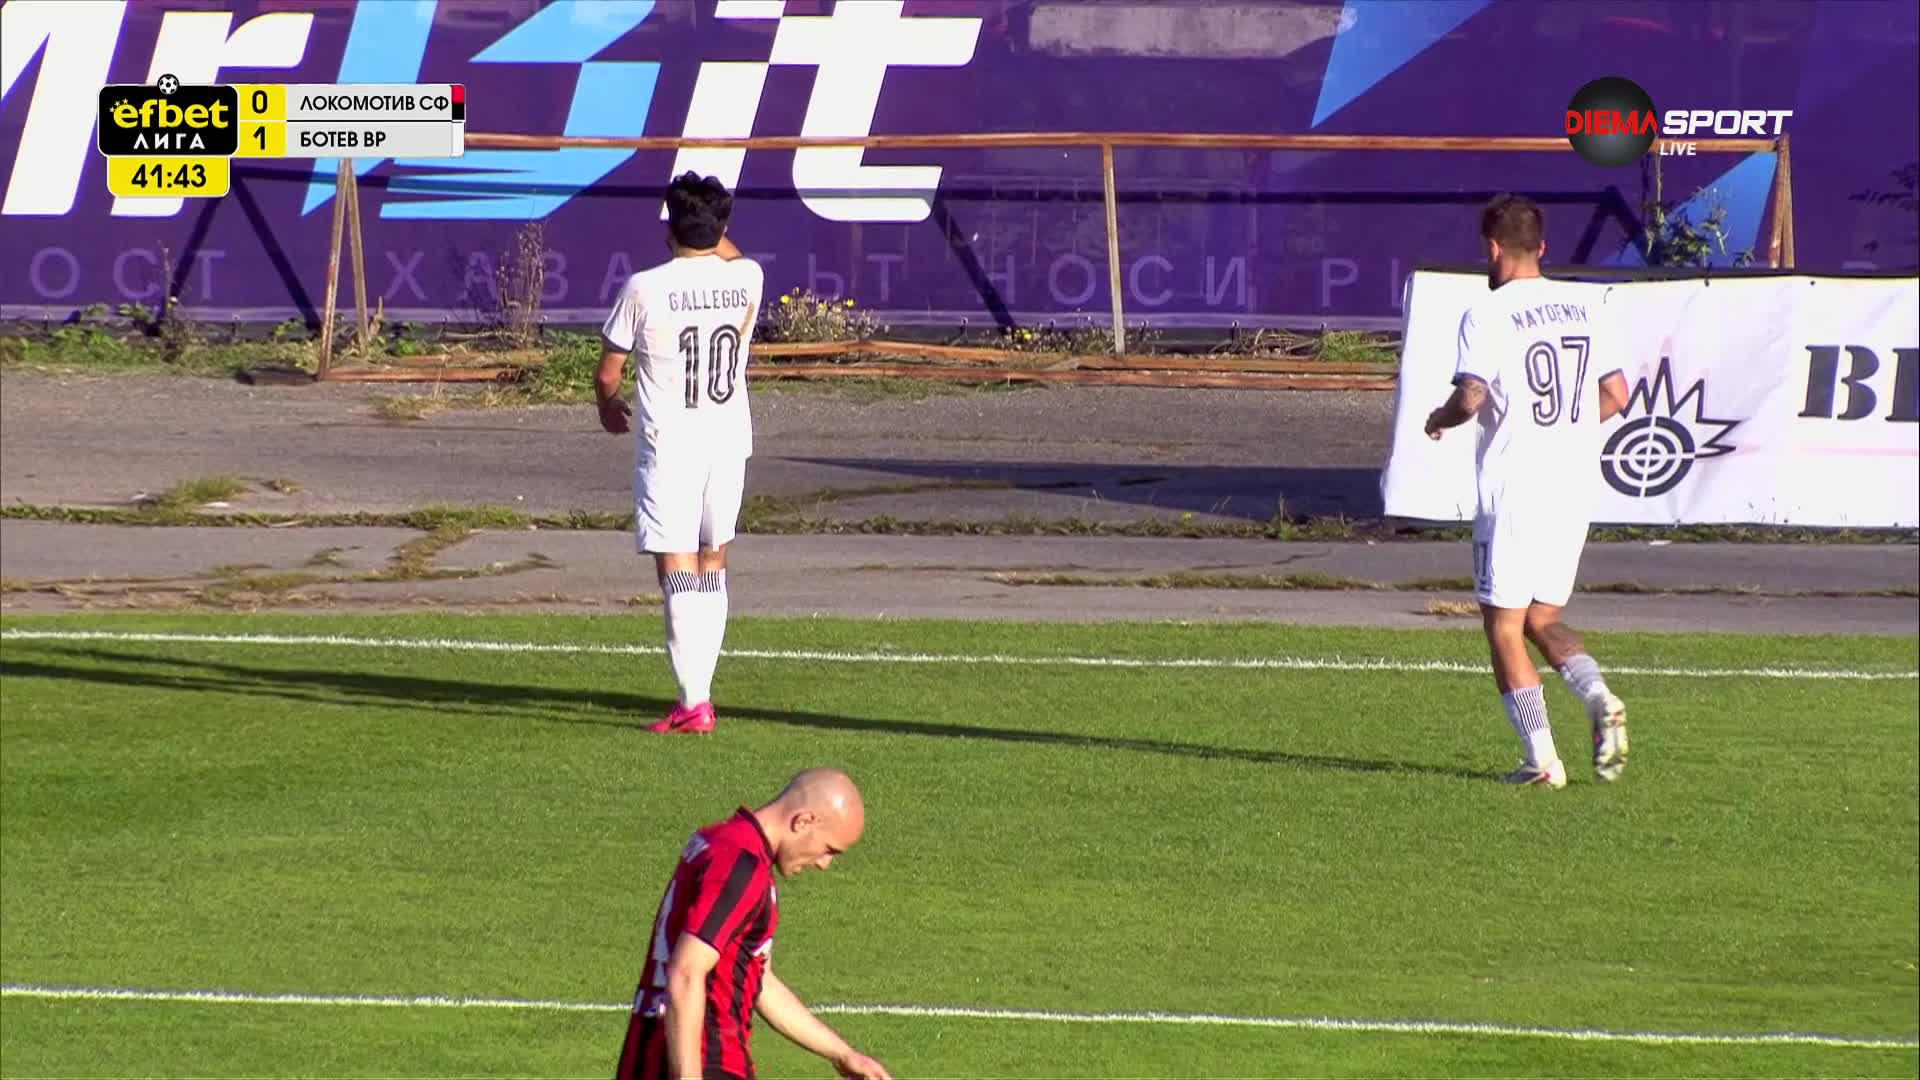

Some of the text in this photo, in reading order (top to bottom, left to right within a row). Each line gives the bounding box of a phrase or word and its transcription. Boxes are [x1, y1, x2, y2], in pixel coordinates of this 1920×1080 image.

[668, 288, 748, 312] GALLEGOS
[1511, 303, 1588, 331] NAYDENOV
[679, 324, 741, 408] 10
[1525, 336, 1590, 426] 97
